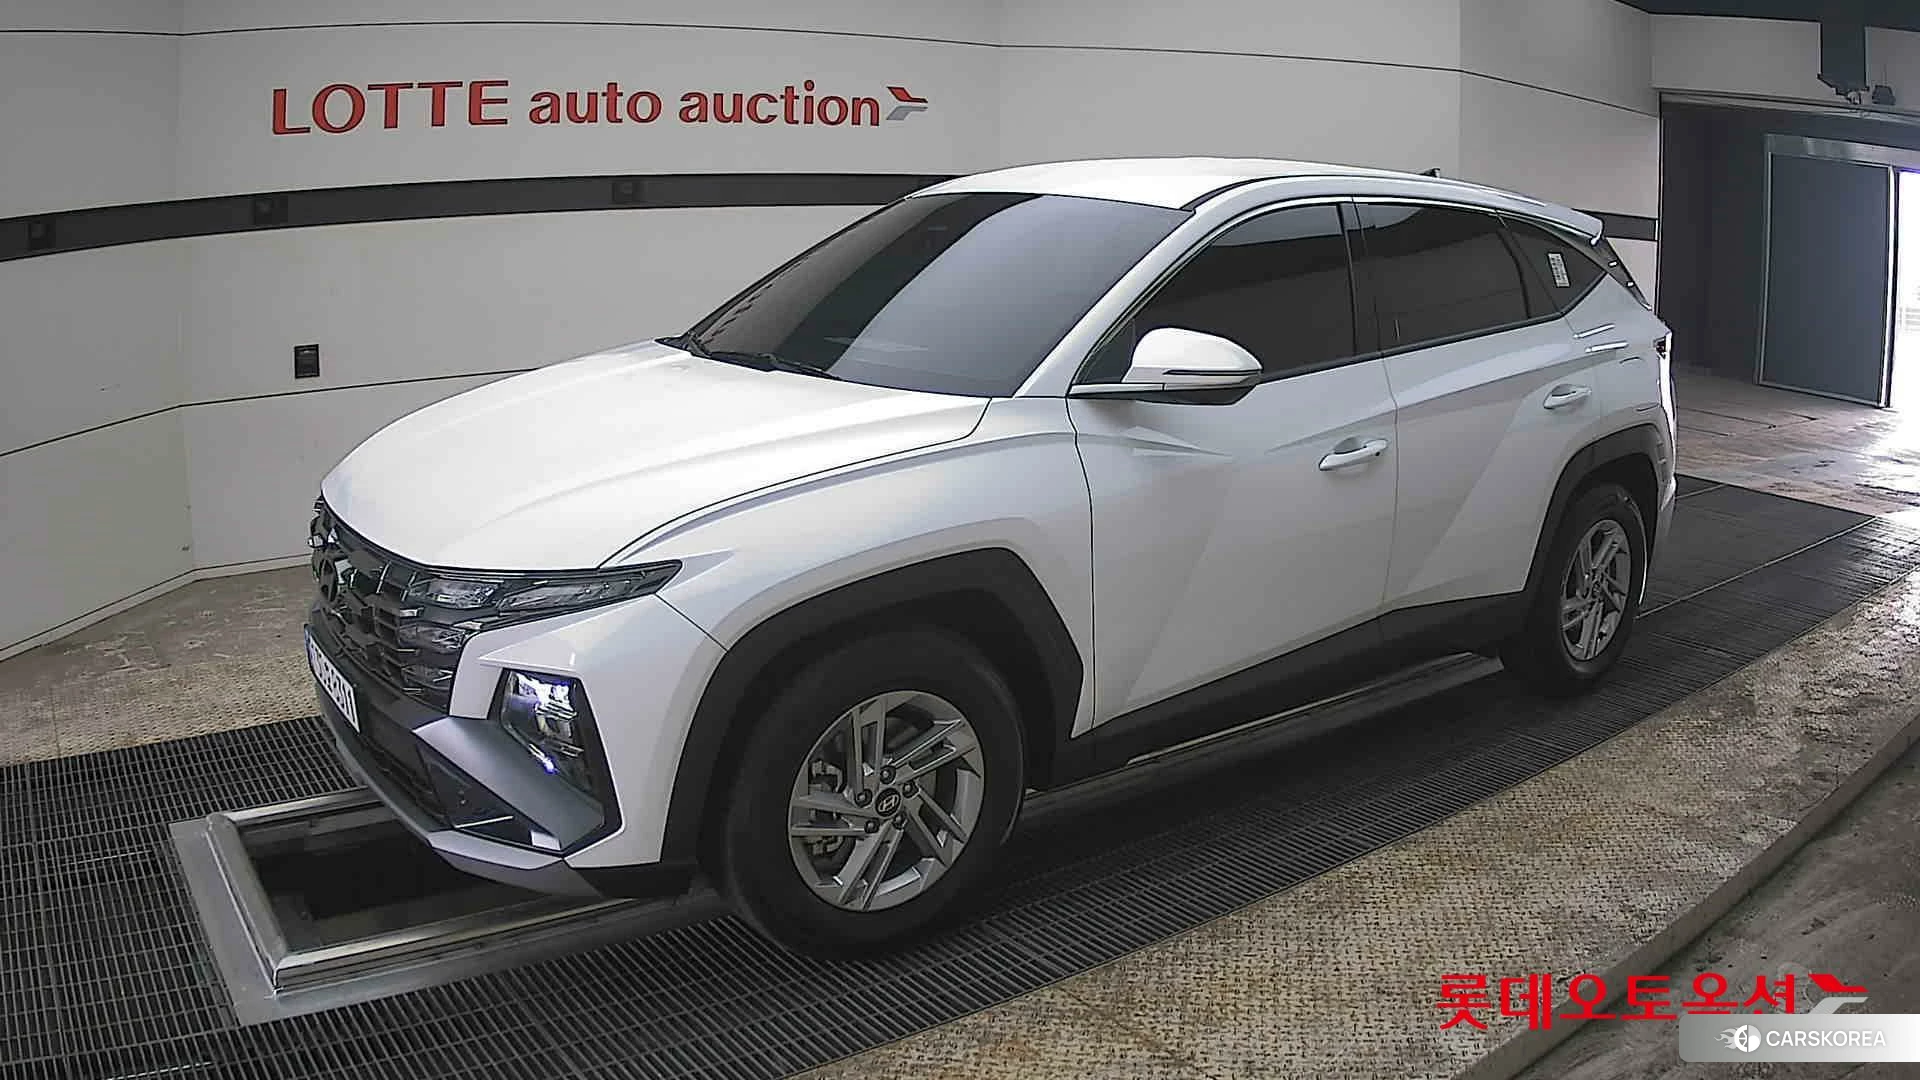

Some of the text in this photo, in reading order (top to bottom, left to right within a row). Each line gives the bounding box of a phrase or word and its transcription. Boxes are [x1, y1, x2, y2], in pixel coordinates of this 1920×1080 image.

[272, 80, 880, 136] LOTTE auto auction
